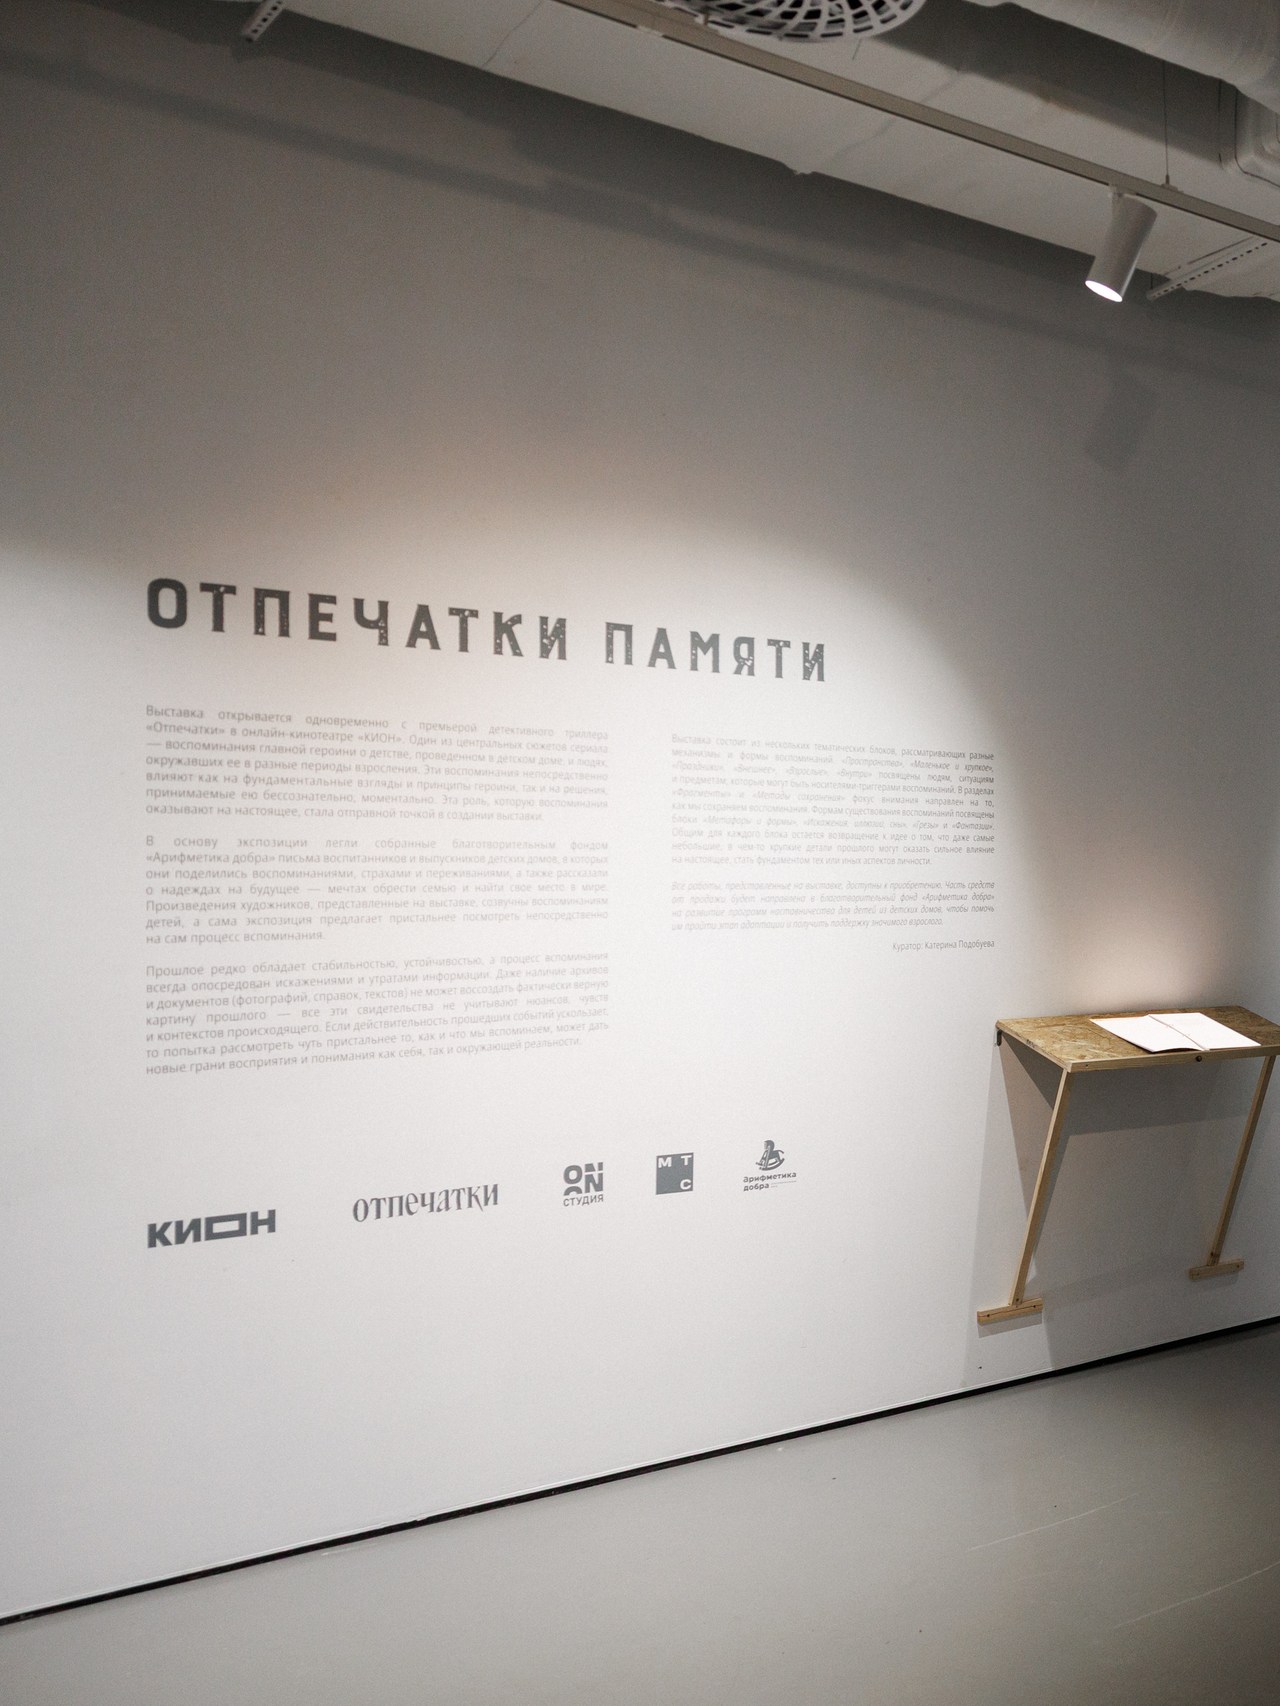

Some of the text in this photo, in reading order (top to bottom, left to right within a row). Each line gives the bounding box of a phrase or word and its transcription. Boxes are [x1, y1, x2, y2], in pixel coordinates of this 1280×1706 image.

[146, 577, 827, 683] ОТПЕЧАТКИ ПАМЯТИ
[146, 704, 204, 719] Выставка
[218, 710, 292, 724] открывается
[305, 715, 388, 729] одновременно
[418, 721, 477, 735] премьерой
[146, 720, 225, 735] «Отпечатки»
[241, 726, 353, 744] онлайн-кинотеатре
[408, 733, 436, 746] Один
[456, 738, 522, 750] центральных
[164, 740, 256, 753] воспоминания
[259, 743, 306, 755] главной
[309, 746, 356, 758] героини
[414, 751, 485, 762] проведенном
[496, 754, 536, 764] детском
[146, 755, 223, 769] окружавших
[254, 759, 297, 771] разные
[300, 761, 351, 774] периоды
[444, 766, 519, 778] воспоминания
[146, 771, 192, 782] влияют
[242, 772, 352, 787] фундаментальные
[356, 778, 402, 790] взгляды
[416, 780, 471, 792] принципы
[146, 788, 235, 800] принимаемые
[494, 797, 534, 809] которую
[146, 804, 212, 815] оказывают
[304, 807, 334, 817] стала
[337, 807, 396, 820] отправной
[399, 807, 435, 819] точкой
[446, 810, 494, 821] создании
[173, 837, 556, 852] основу экспозиции легли собранные благотворительным
[146, 850, 230, 866] «Арифметика
[232, 851, 275, 866] добра»
[278, 854, 320, 863] письма
[322, 854, 406, 863] воспитанников
[418, 854, 485, 866] выпускников
[488, 855, 525, 865] детских
[174, 869, 246, 880] поделились
[360, 869, 412, 881] страхами
[160, 885, 220, 897] надеждах
[249, 882, 299, 897] будущее
[327, 884, 366, 894] мечтах
[372, 882, 416, 896] обрести
[421, 884, 456, 893] семью
[474, 881, 504, 892] найти
[146, 899, 236, 914] Произведения
[317, 899, 408, 912] представленные
[481, 898, 528, 909] созвучны
[208, 917, 237, 927] сама
[246, 915, 312, 927] экспозиция
[320, 914, 382, 927] предлагает
[389, 913, 456, 926] пристальнее
[462, 912, 520, 924] посмотреть
[190, 932, 238, 946] процесс
[146, 964, 204, 980] Прошлое
[210, 964, 246, 977] редко
[252, 961, 305, 974] обладает
[500, 954, 539, 966] процесс
[146, 982, 186, 994] всегда
[191, 979, 270, 993] опосредован
[275, 976, 352, 988] искажениями
[368, 973, 418, 987] утратами
[496, 967, 522, 979] Даже
[156, 996, 229, 1011] документов
[364, 986, 408, 1000] текстов)
[424, 986, 456, 996] может
[459, 984, 514, 995] воссоздать
[146, 1014, 195, 1028] картину
[206, 1010, 266, 1025] прошлого
[356, 1002, 434, 1015] свидетельства
[464, 998, 518, 1012] учитывают
[156, 1028, 224, 1041] контекстов
[324, 1020, 350, 1032] Если
[353, 1016, 447, 1032] действительность
[450, 1013, 510, 1027] прошедших
[146, 1063, 186, 1075] новые
[189, 1060, 225, 1074] грани
[228, 1055, 297, 1070] восприятия
[311, 1050, 375, 1063] понимания
[456, 1038, 522, 1055] окружающей
[163, 1045, 216, 1057] попытка
[220, 1040, 293, 1057] рассмотреть
[298, 1038, 322, 1051] чуть
[326, 1034, 396, 1049] пристальнее
[743, 1183, 770, 1192] добра
[352, 1183, 500, 1222] отпечатки
[563, 1193, 604, 1206] СТУДИЯ
[147, 1209, 276, 1248] КИОН
